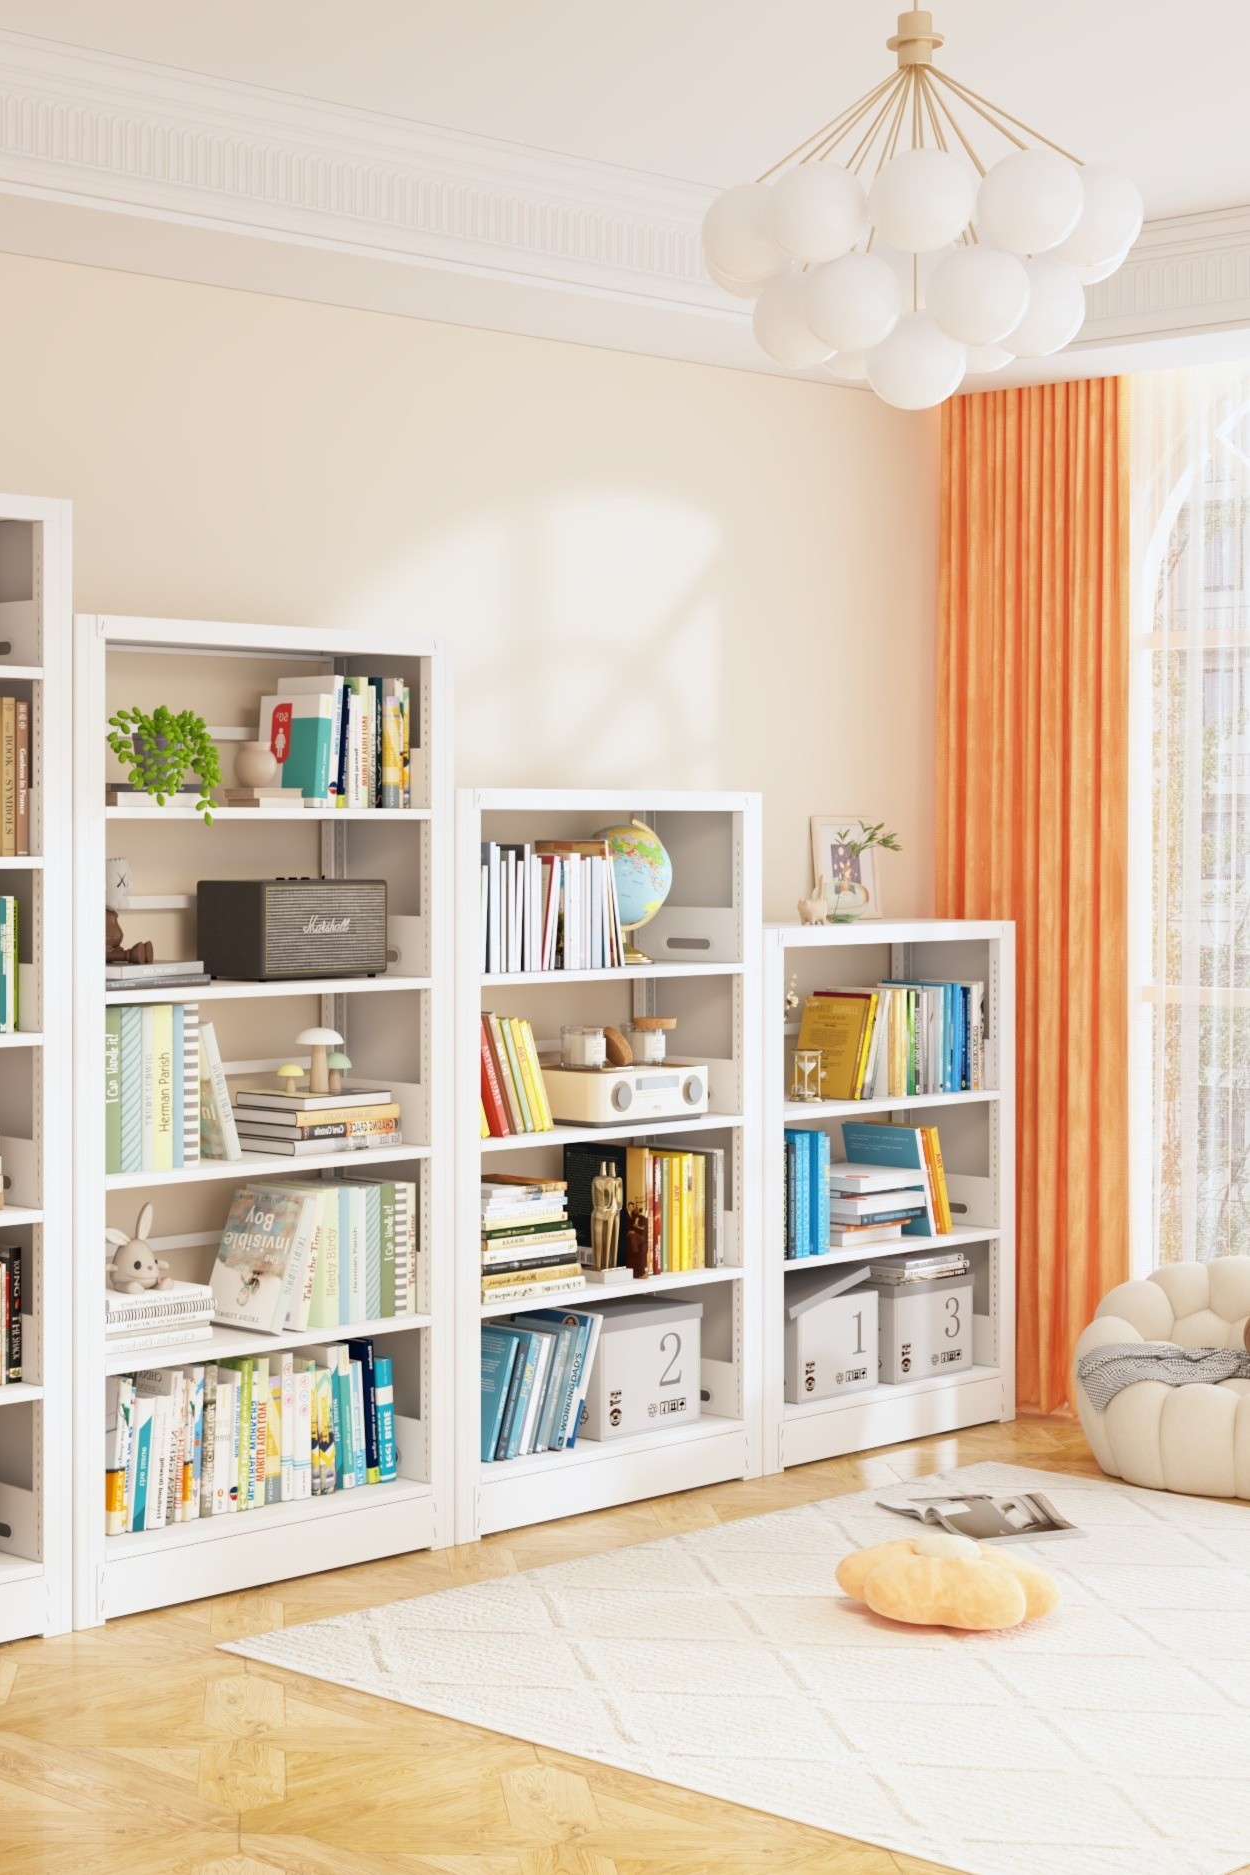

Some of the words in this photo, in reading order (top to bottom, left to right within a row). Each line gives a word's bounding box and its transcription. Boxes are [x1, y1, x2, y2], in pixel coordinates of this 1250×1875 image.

[6, 736, 14, 767] BOOK
[20, 780, 26, 788] in
[6, 780, 14, 836] SYMBOLS
[303, 915, 351, 935] Marshall
[106, 1034, 119, 1045] it!
[106, 1047, 119, 1074] Handle
[159, 1052, 170, 1085] Parish
[107, 1080, 119, 1097] Can
[482, 1044, 502, 1106] ANTIQUAIRES
[159, 1088, 170, 1132] Herman
[245, 1205, 276, 1232] Boy
[383, 1205, 394, 1215] it!
[311, 1225, 322, 1253] Time
[384, 1216, 394, 1238] Handle
[224, 1229, 292, 1255] Invisible
[326, 1228, 337, 1259] Birdy
[385, 1242, 394, 1256] Can
[264, 1254, 280, 1265] The
[308, 1256, 317, 1273] the
[13, 1260, 22, 1297] YOUNG
[303, 1276, 314, 1302] Take
[326, 1262, 337, 1296] Nerdy
[12, 1316, 22, 1336] THE
[945, 1297, 961, 1338] 3
[852, 1310, 867, 1355] 1
[12, 1336, 22, 1360] SHACK
[660, 1332, 682, 1387] 2
[558, 1383, 576, 1432] WORKING
[570, 1352, 582, 1383] DAD'S
